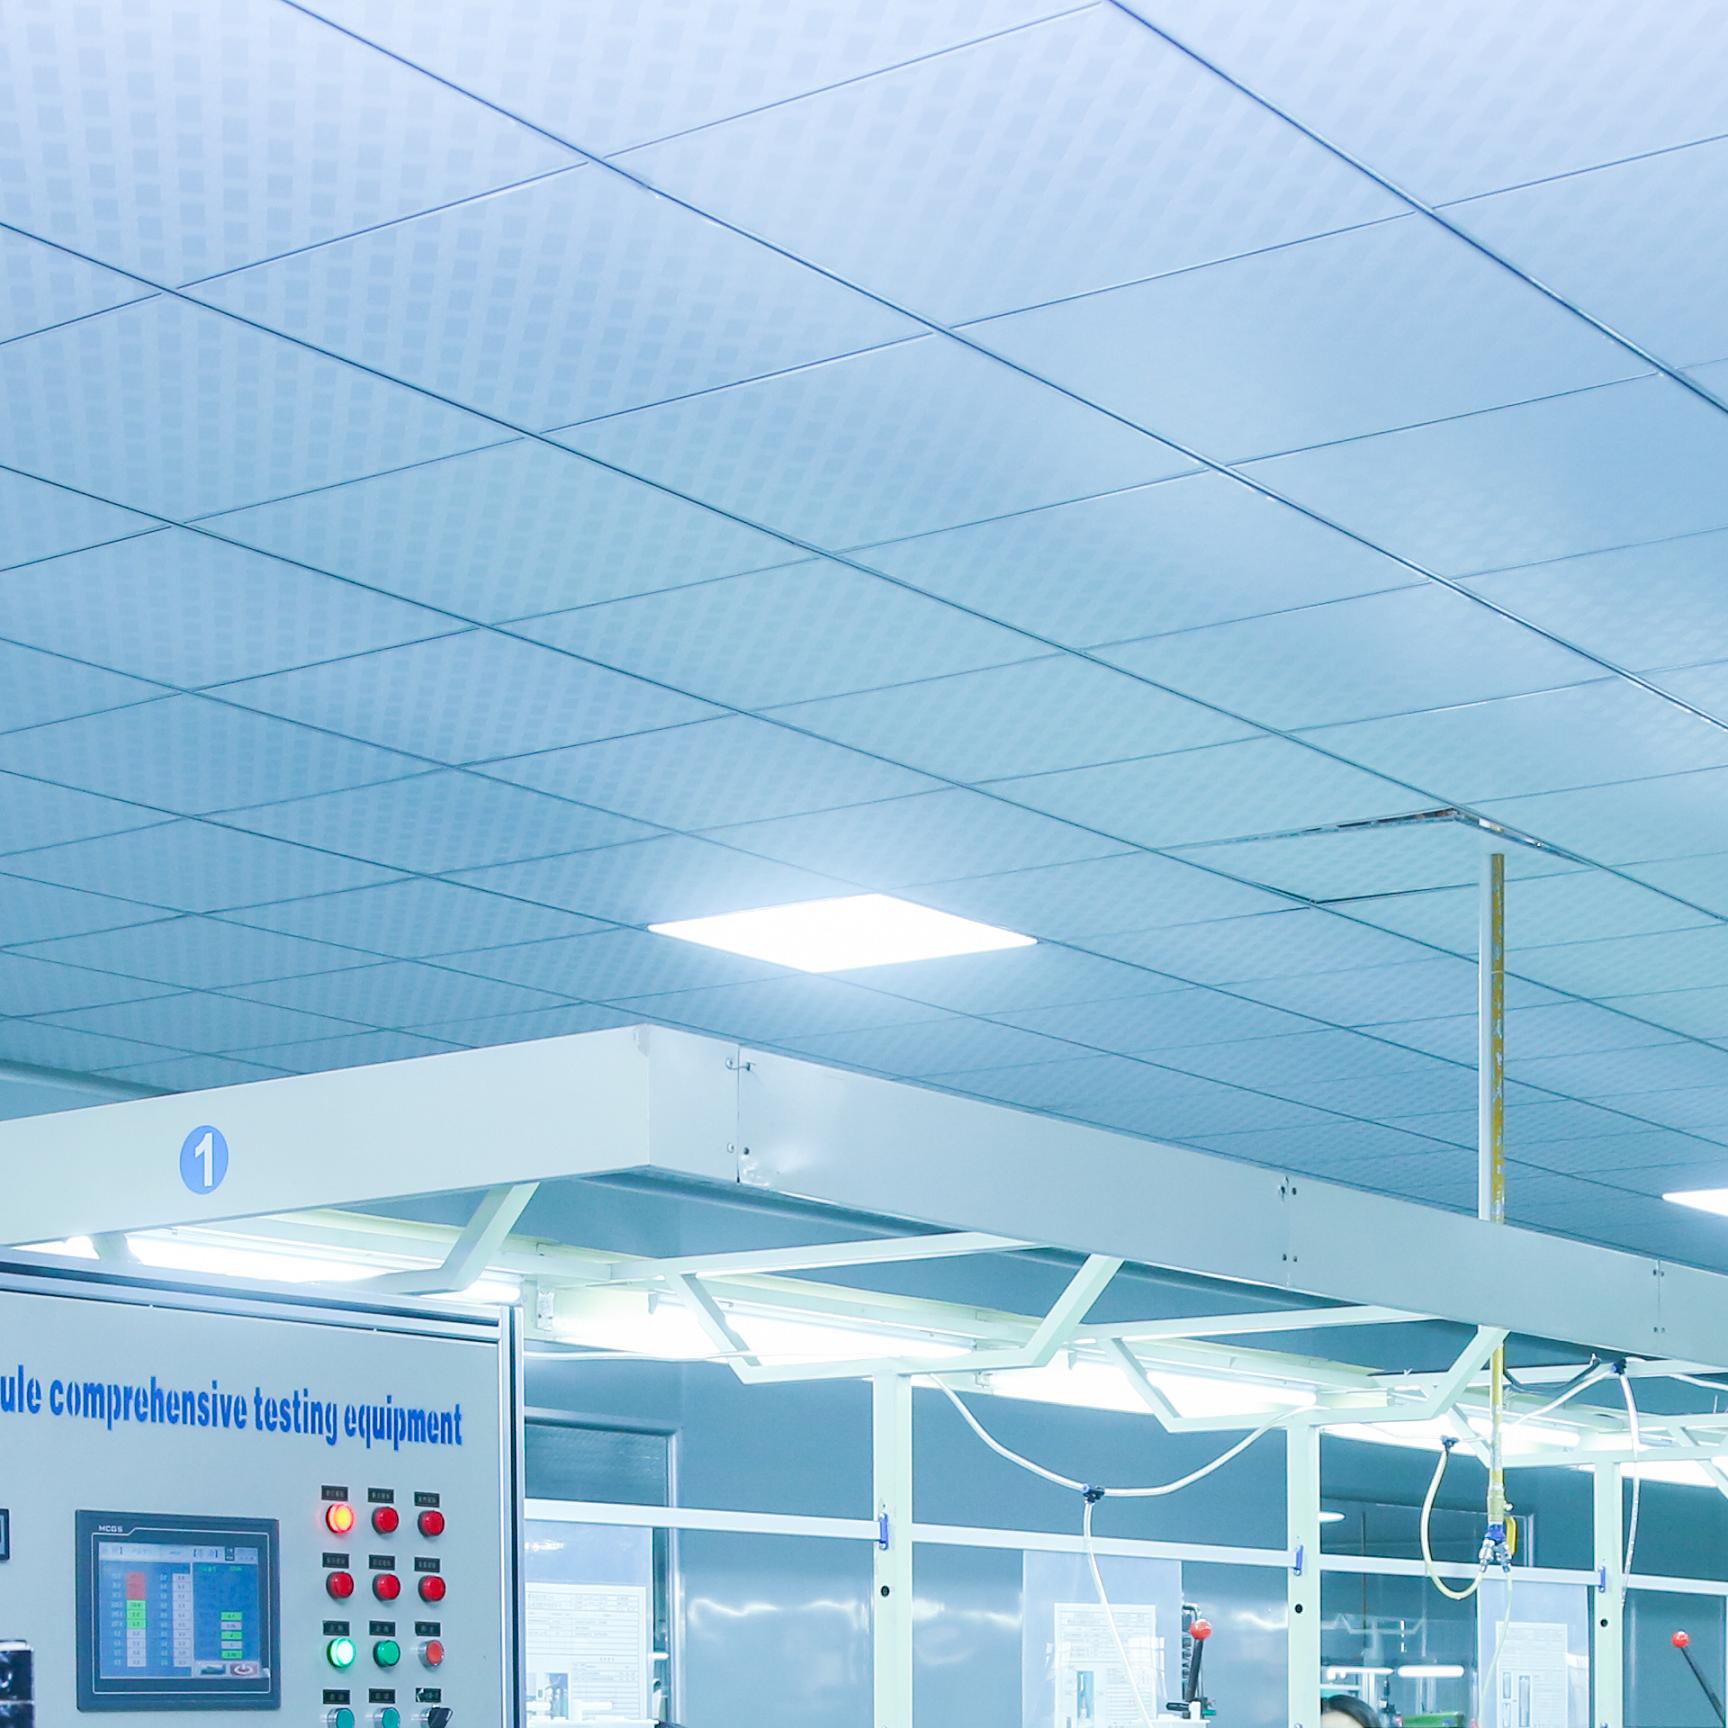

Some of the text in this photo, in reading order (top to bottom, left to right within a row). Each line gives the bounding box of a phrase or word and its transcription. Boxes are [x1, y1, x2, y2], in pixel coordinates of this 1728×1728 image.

[194, 1132, 213, 1187] 1
[50, 1376, 248, 1431] comprehensive
[254, 1387, 338, 1446] testing
[344, 1395, 463, 1451] equipment
